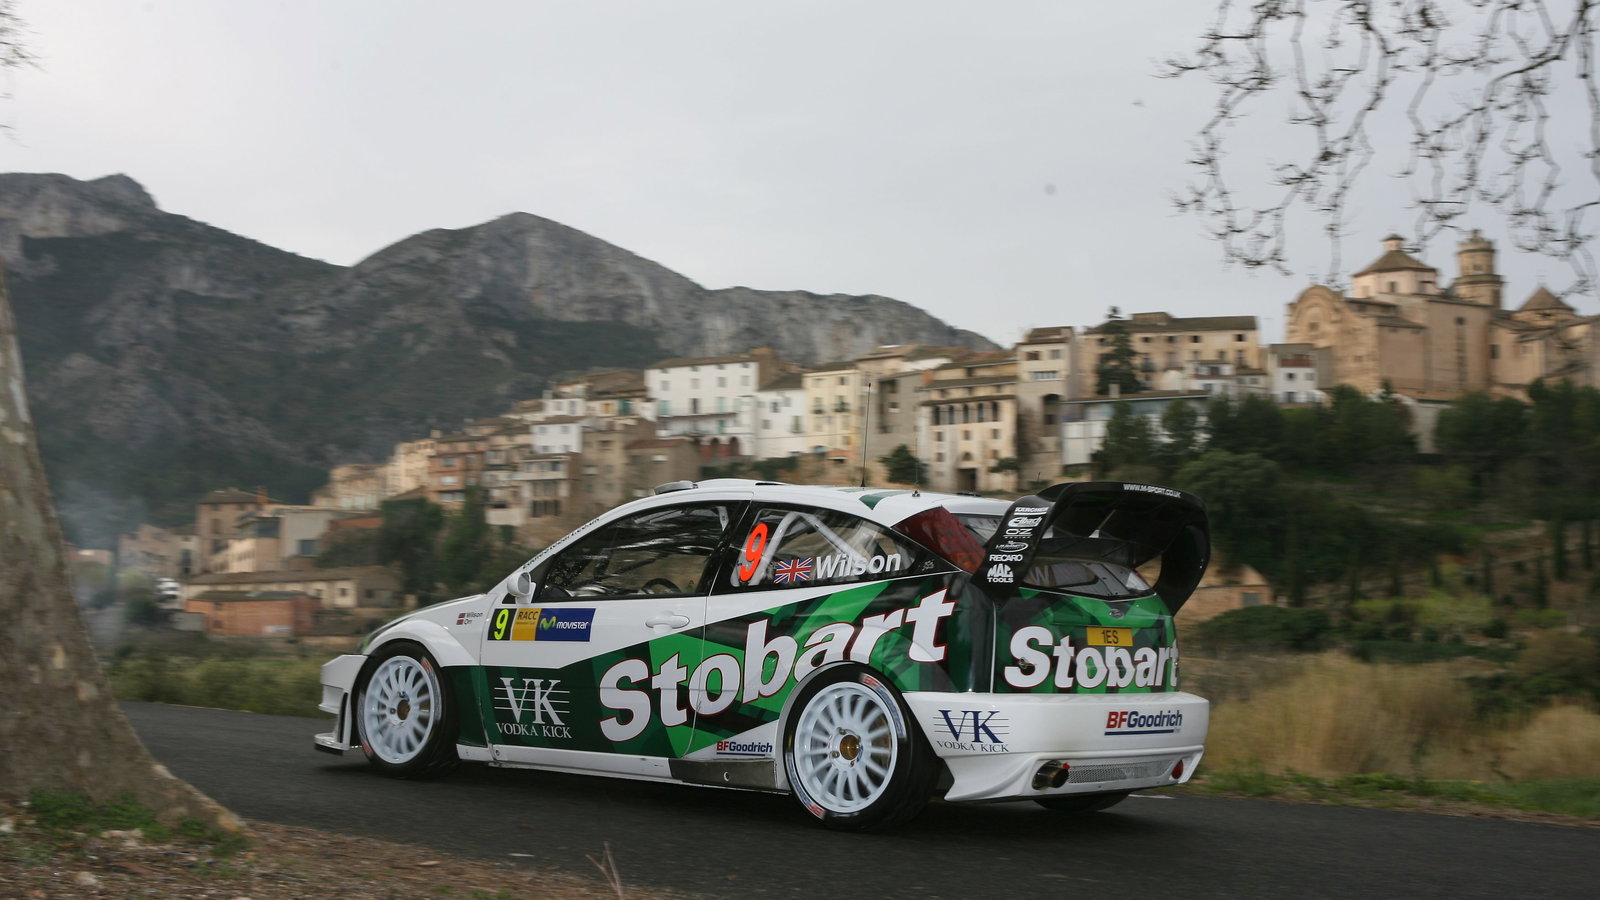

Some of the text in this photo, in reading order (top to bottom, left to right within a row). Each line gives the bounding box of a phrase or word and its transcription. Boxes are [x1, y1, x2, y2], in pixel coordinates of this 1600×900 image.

[739, 523, 901, 581] 9 Wilson
[989, 554, 1023, 562] RECARO
[987, 563, 1014, 578] MAC
[494, 608, 509, 640] 9
[517, 610, 538, 621] RACC
[556, 620, 589, 630] movistar
[1101, 629, 1119, 644] 1ES
[599, 587, 956, 742] Stobart
[1004, 625, 1179, 688] Stobart
[499, 677, 565, 726] VK
[938, 709, 1004, 744] VK
[1106, 710, 1183, 729] BFGoodrich
[496, 722, 573, 739] VODKA KICK
[716, 741, 773, 753] BFGoodrich
[936, 740, 1010, 752] VODKA KICK
